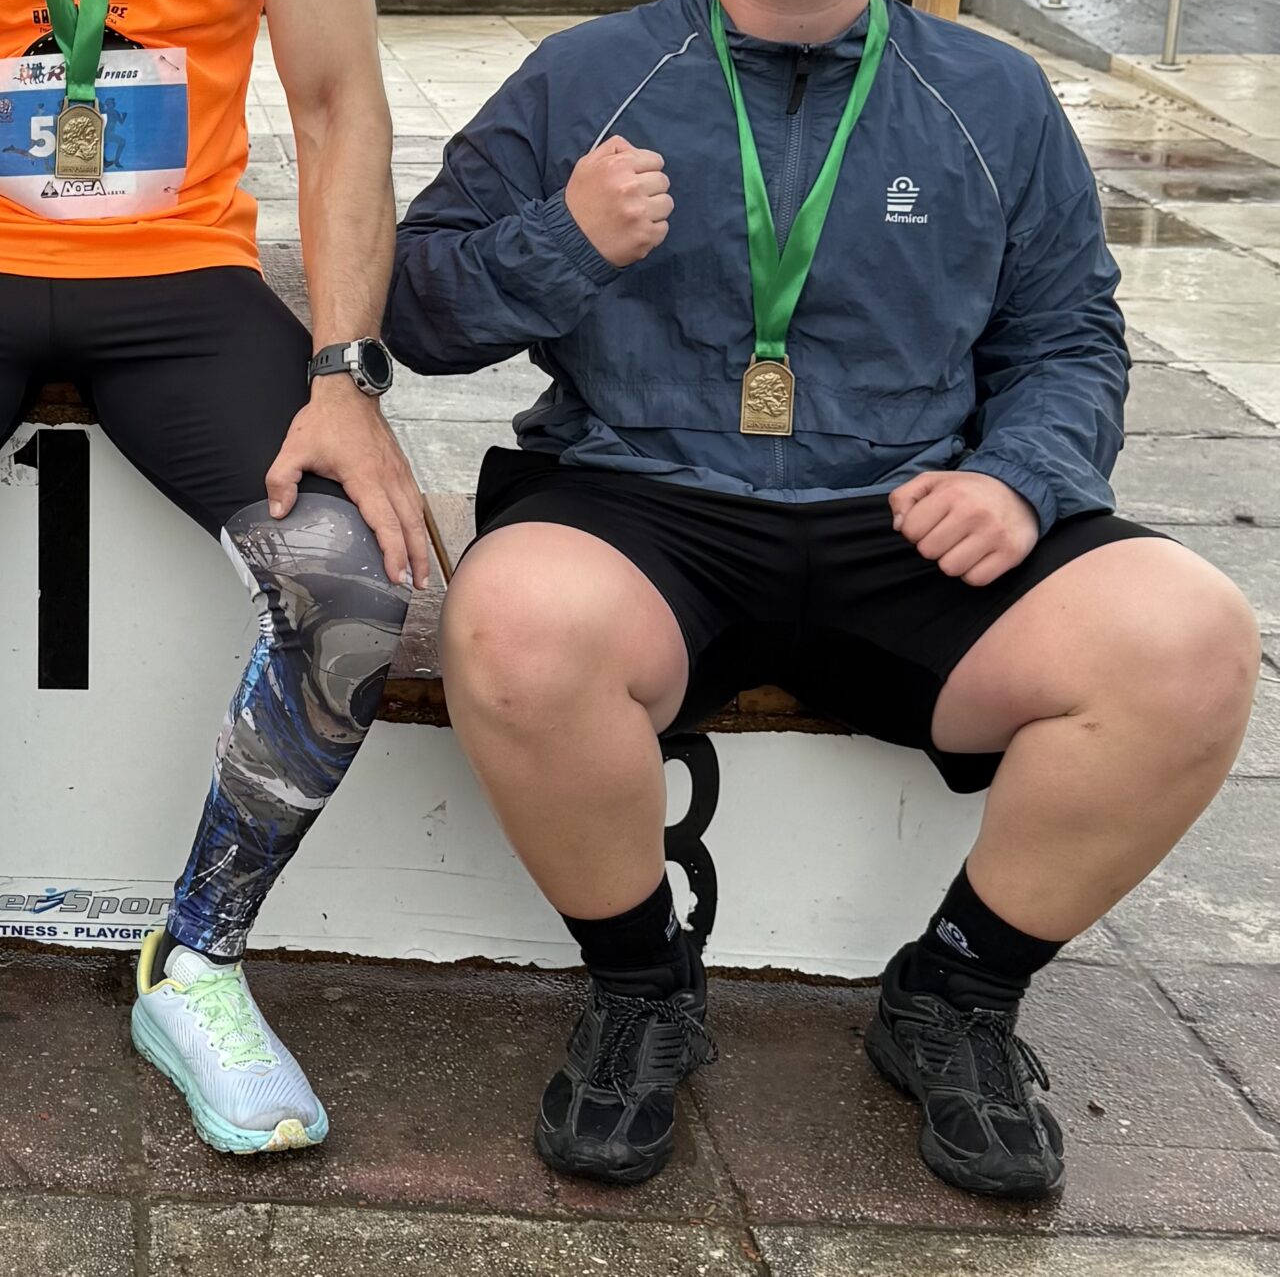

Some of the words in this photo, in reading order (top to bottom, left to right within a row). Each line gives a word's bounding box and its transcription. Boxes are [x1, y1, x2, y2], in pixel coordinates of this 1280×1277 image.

[885, 213, 928, 224] Admiral
[14, 429, 91, 690] 1
[60, 890, 172, 918] Spor
